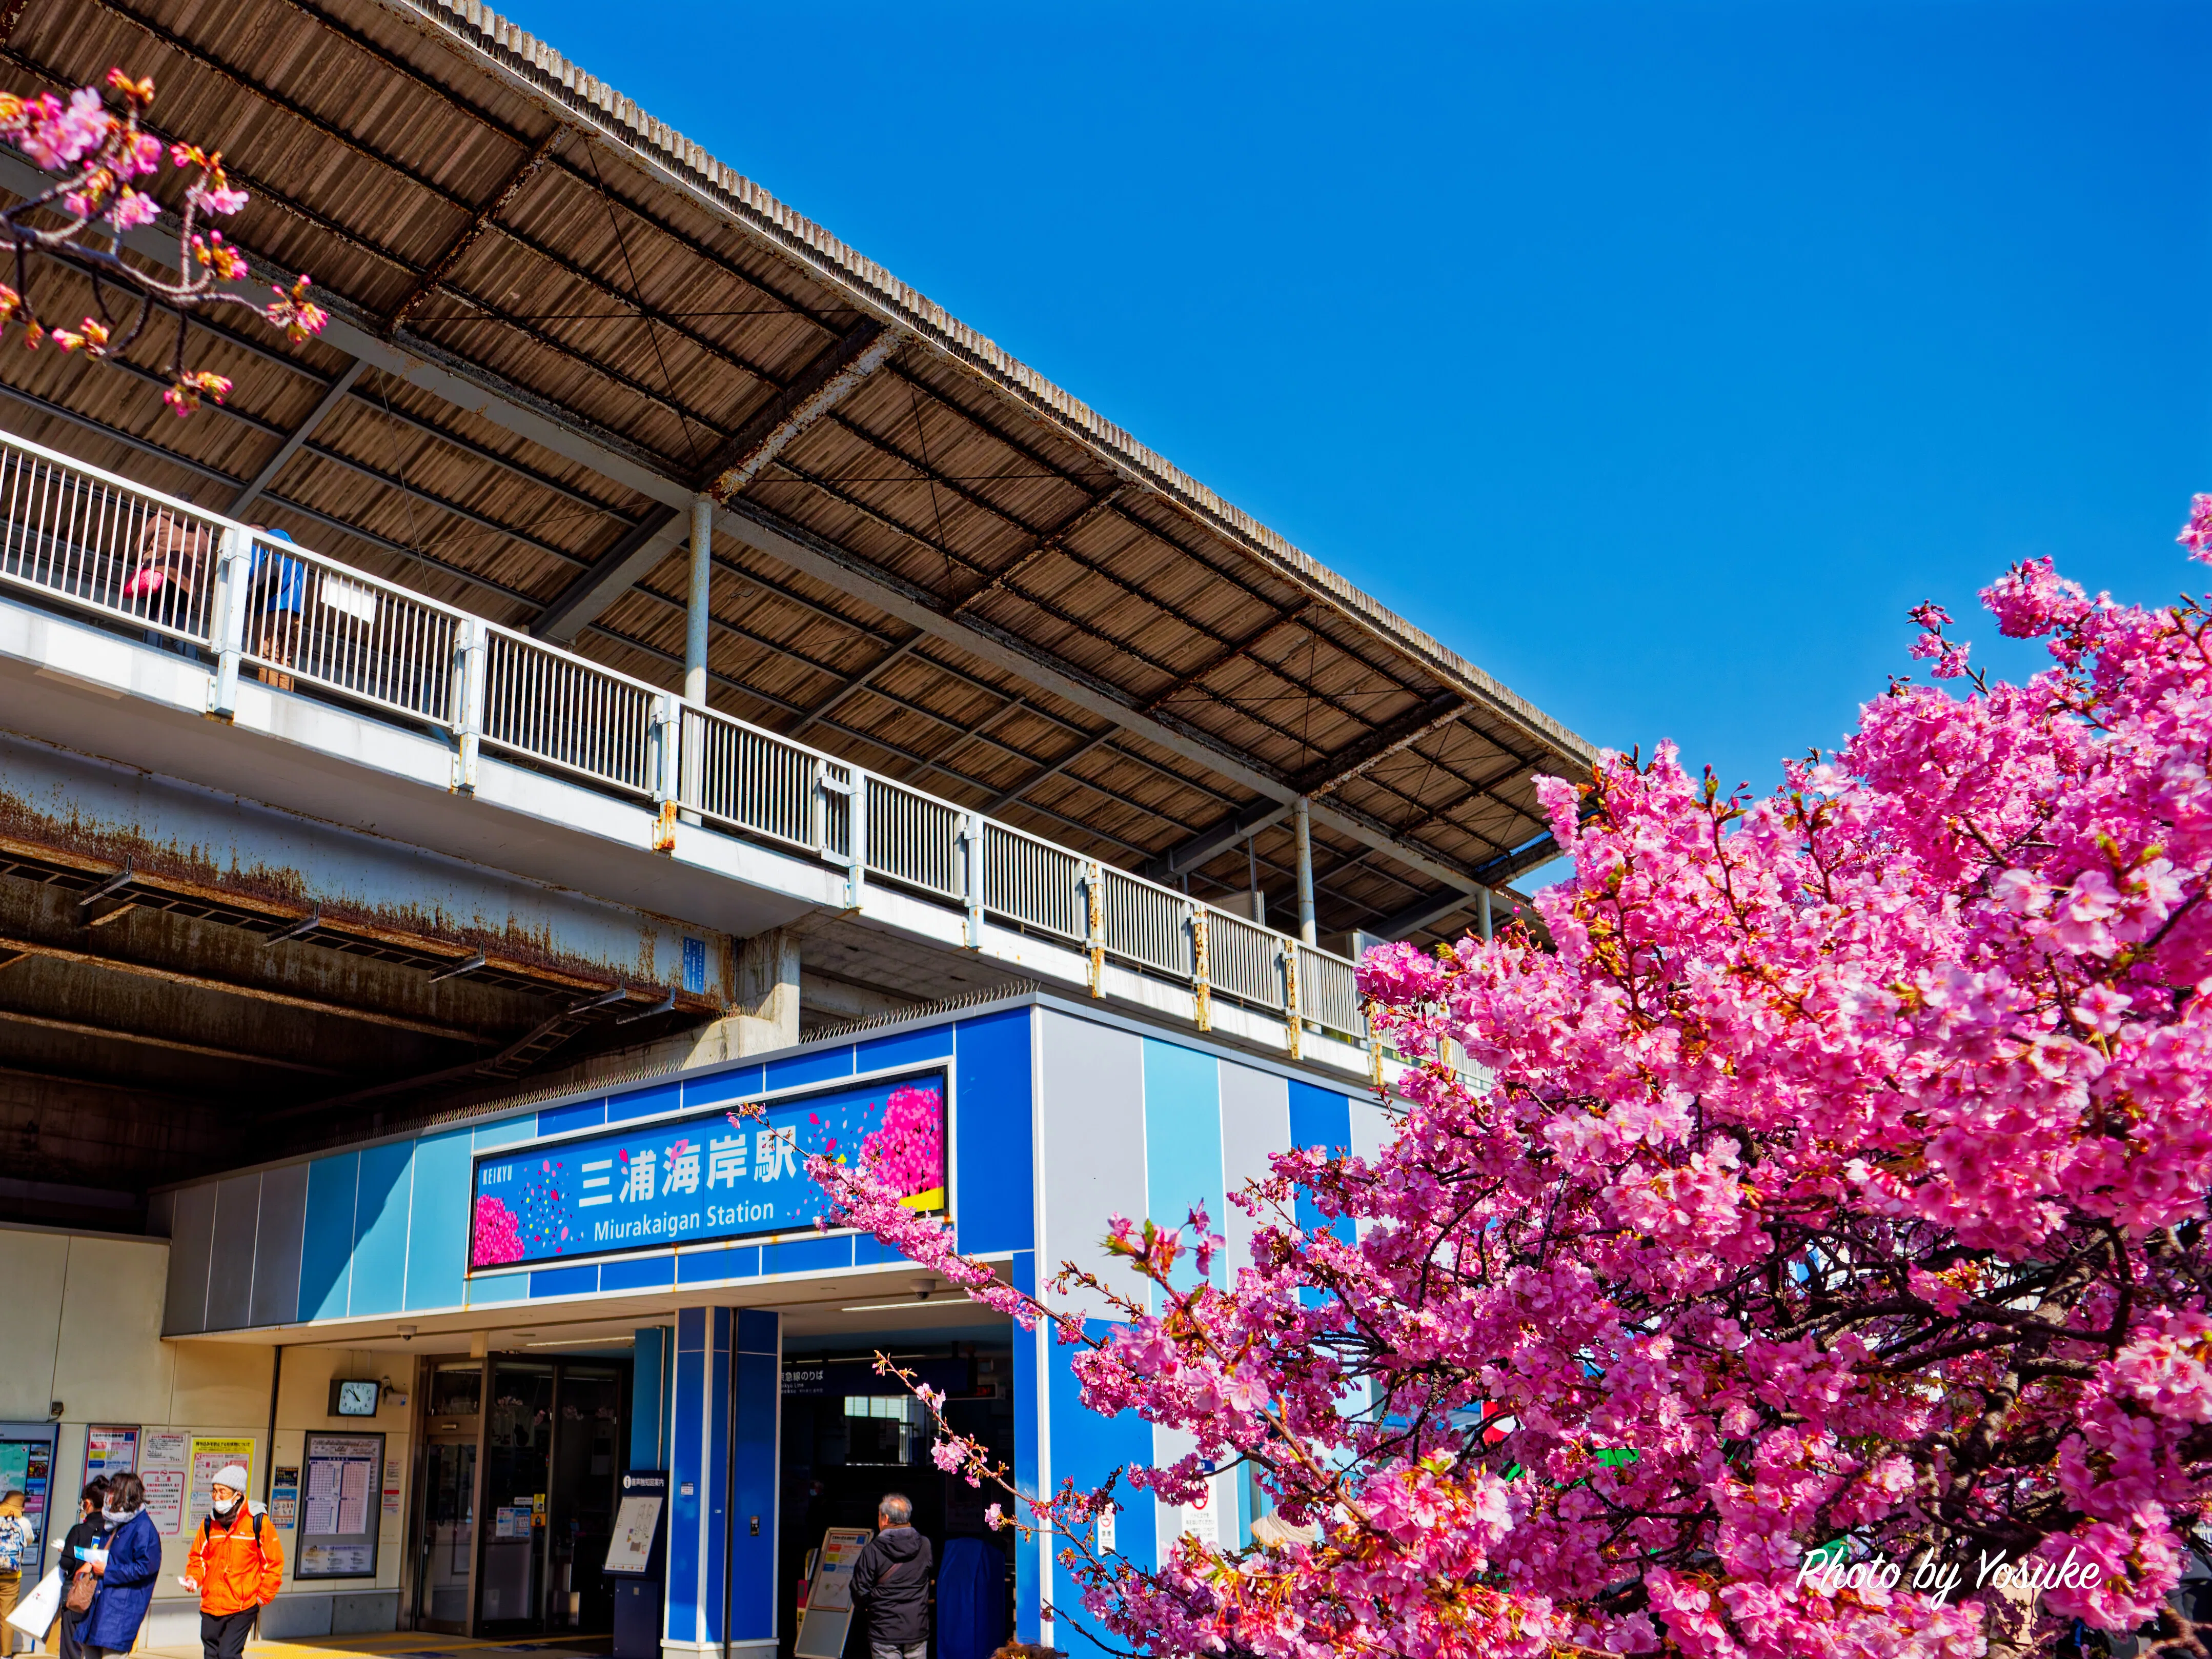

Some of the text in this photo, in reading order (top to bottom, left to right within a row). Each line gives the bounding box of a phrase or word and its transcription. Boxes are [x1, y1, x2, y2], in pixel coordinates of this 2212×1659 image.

[483, 1164, 512, 1185] KEIKYU
[579, 1125, 797, 1208] 三浦海岸駅
[594, 1200, 774, 1242] Miurakaigan Station
